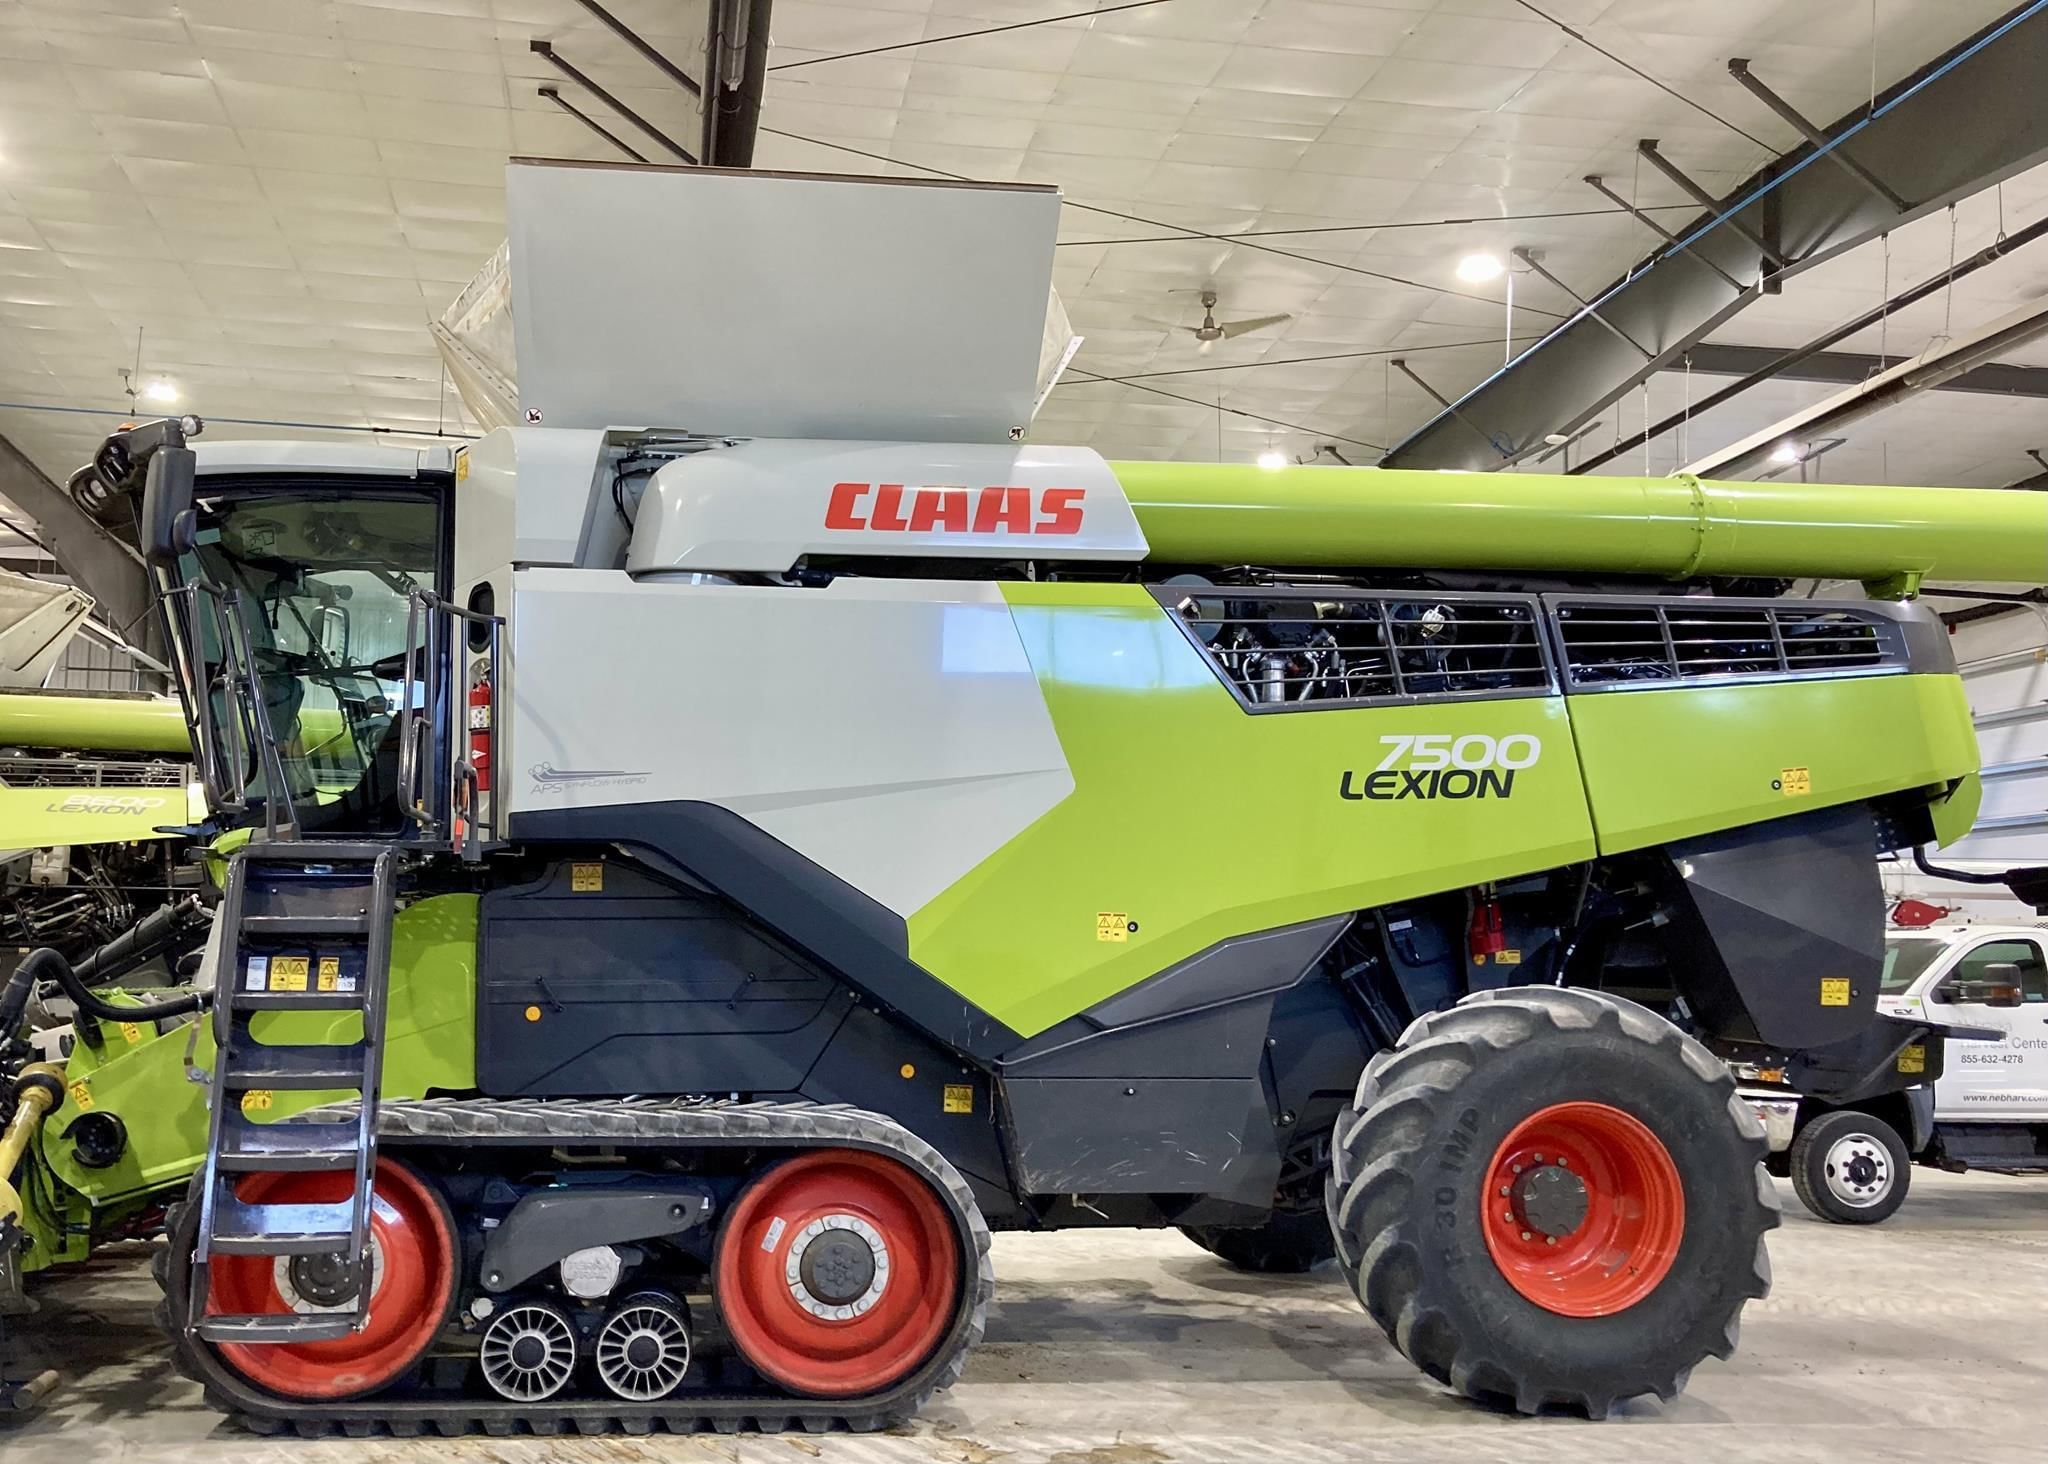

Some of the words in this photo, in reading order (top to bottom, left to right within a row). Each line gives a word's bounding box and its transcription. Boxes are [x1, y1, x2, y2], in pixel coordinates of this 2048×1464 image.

[824, 482, 1087, 535] CLAAS
[1374, 733, 1542, 771] 7500
[530, 782, 563, 795] APS
[1339, 768, 1516, 801] LEXION
[45, 803, 149, 816] LEXION
[1960, 1054, 2024, 1064] 855-632-4278
